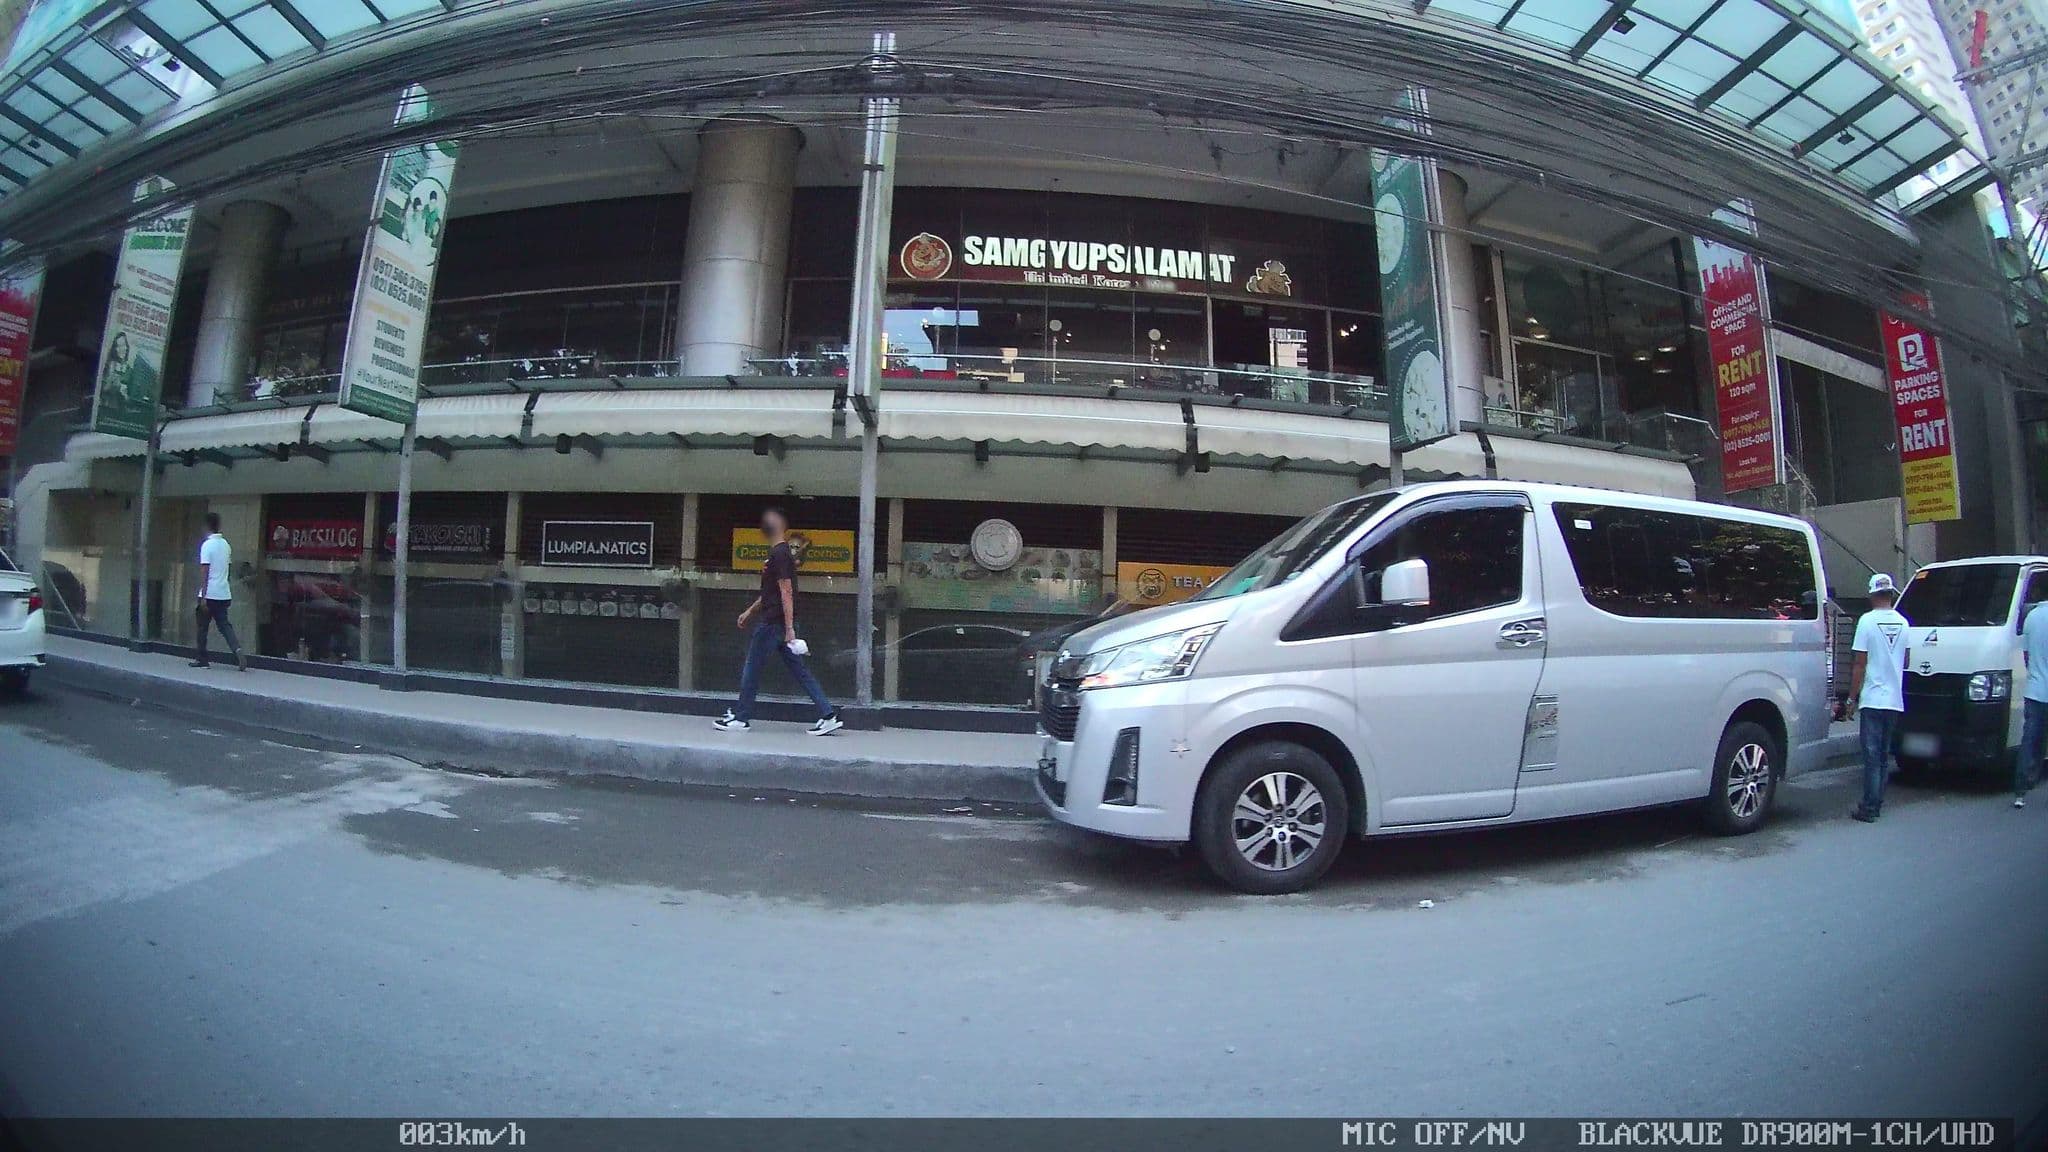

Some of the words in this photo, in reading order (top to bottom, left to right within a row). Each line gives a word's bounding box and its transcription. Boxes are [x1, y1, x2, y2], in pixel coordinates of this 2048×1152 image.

[964, 236, 1236, 283] SAMGYUPSALAMAT
[1711, 302, 1757, 329] COMMERCIAL
[1712, 300, 1737, 318] OFFICE
[1737, 293, 1752, 307] AND
[1724, 318, 1746, 335] SPACE
[1731, 344, 1745, 357] FOR
[1718, 350, 1761, 388] RENT
[1895, 371, 1938, 391] PARKING
[1897, 385, 1940, 405] SPACES
[1914, 409, 1928, 418] FOR
[1901, 419, 1946, 453] RENT
[1173, 576, 1204, 588] TEA
